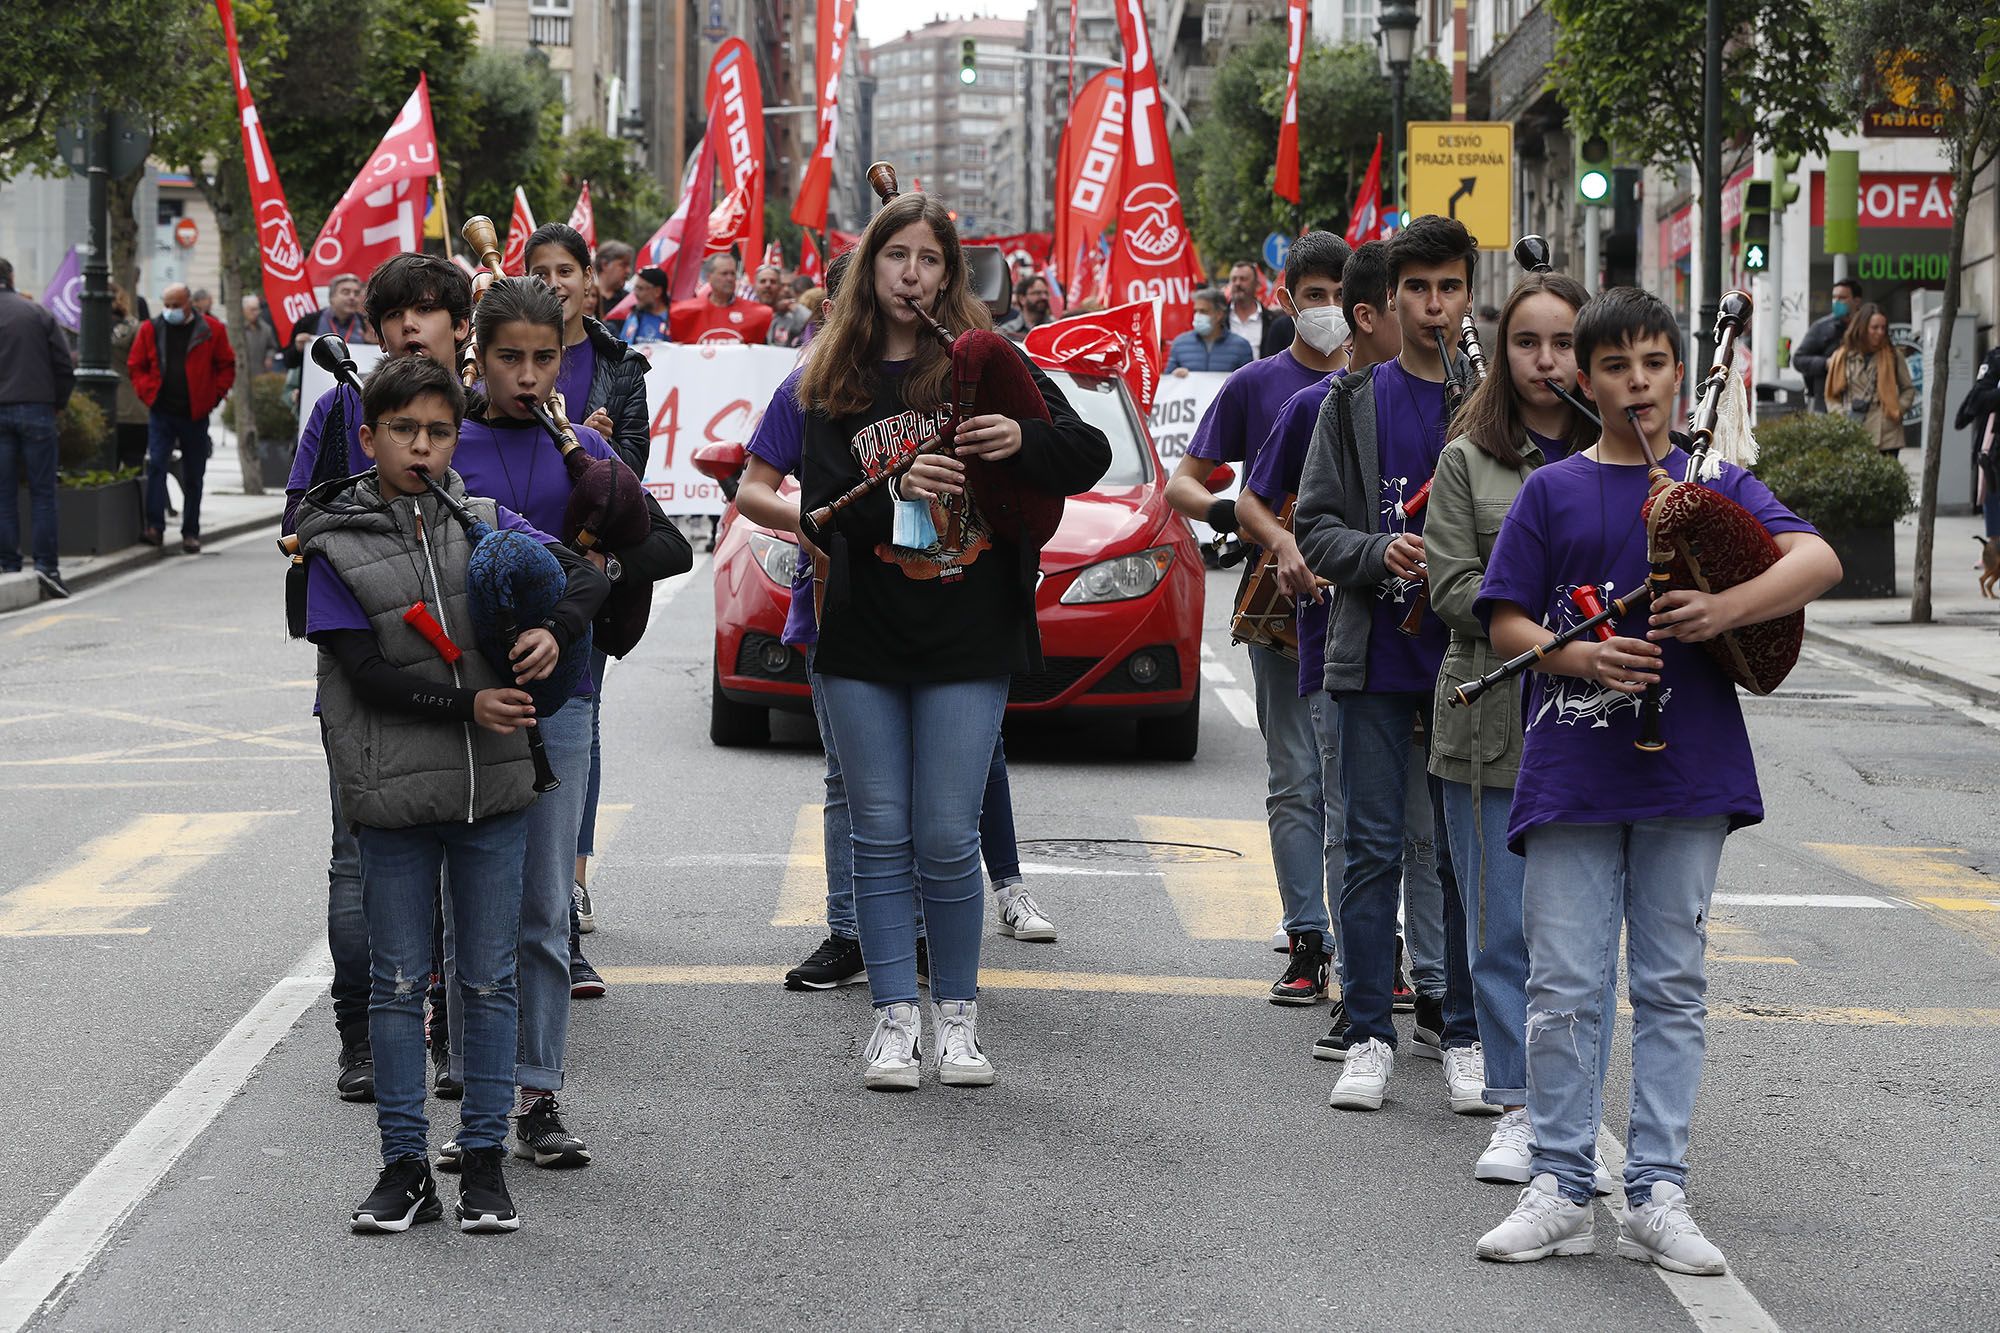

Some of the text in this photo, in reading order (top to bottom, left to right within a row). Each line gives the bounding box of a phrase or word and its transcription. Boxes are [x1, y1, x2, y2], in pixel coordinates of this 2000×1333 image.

[1438, 132, 1482, 148] DESVÍO
[1415, 150, 1504, 165] PRAZA ESPAÑA
